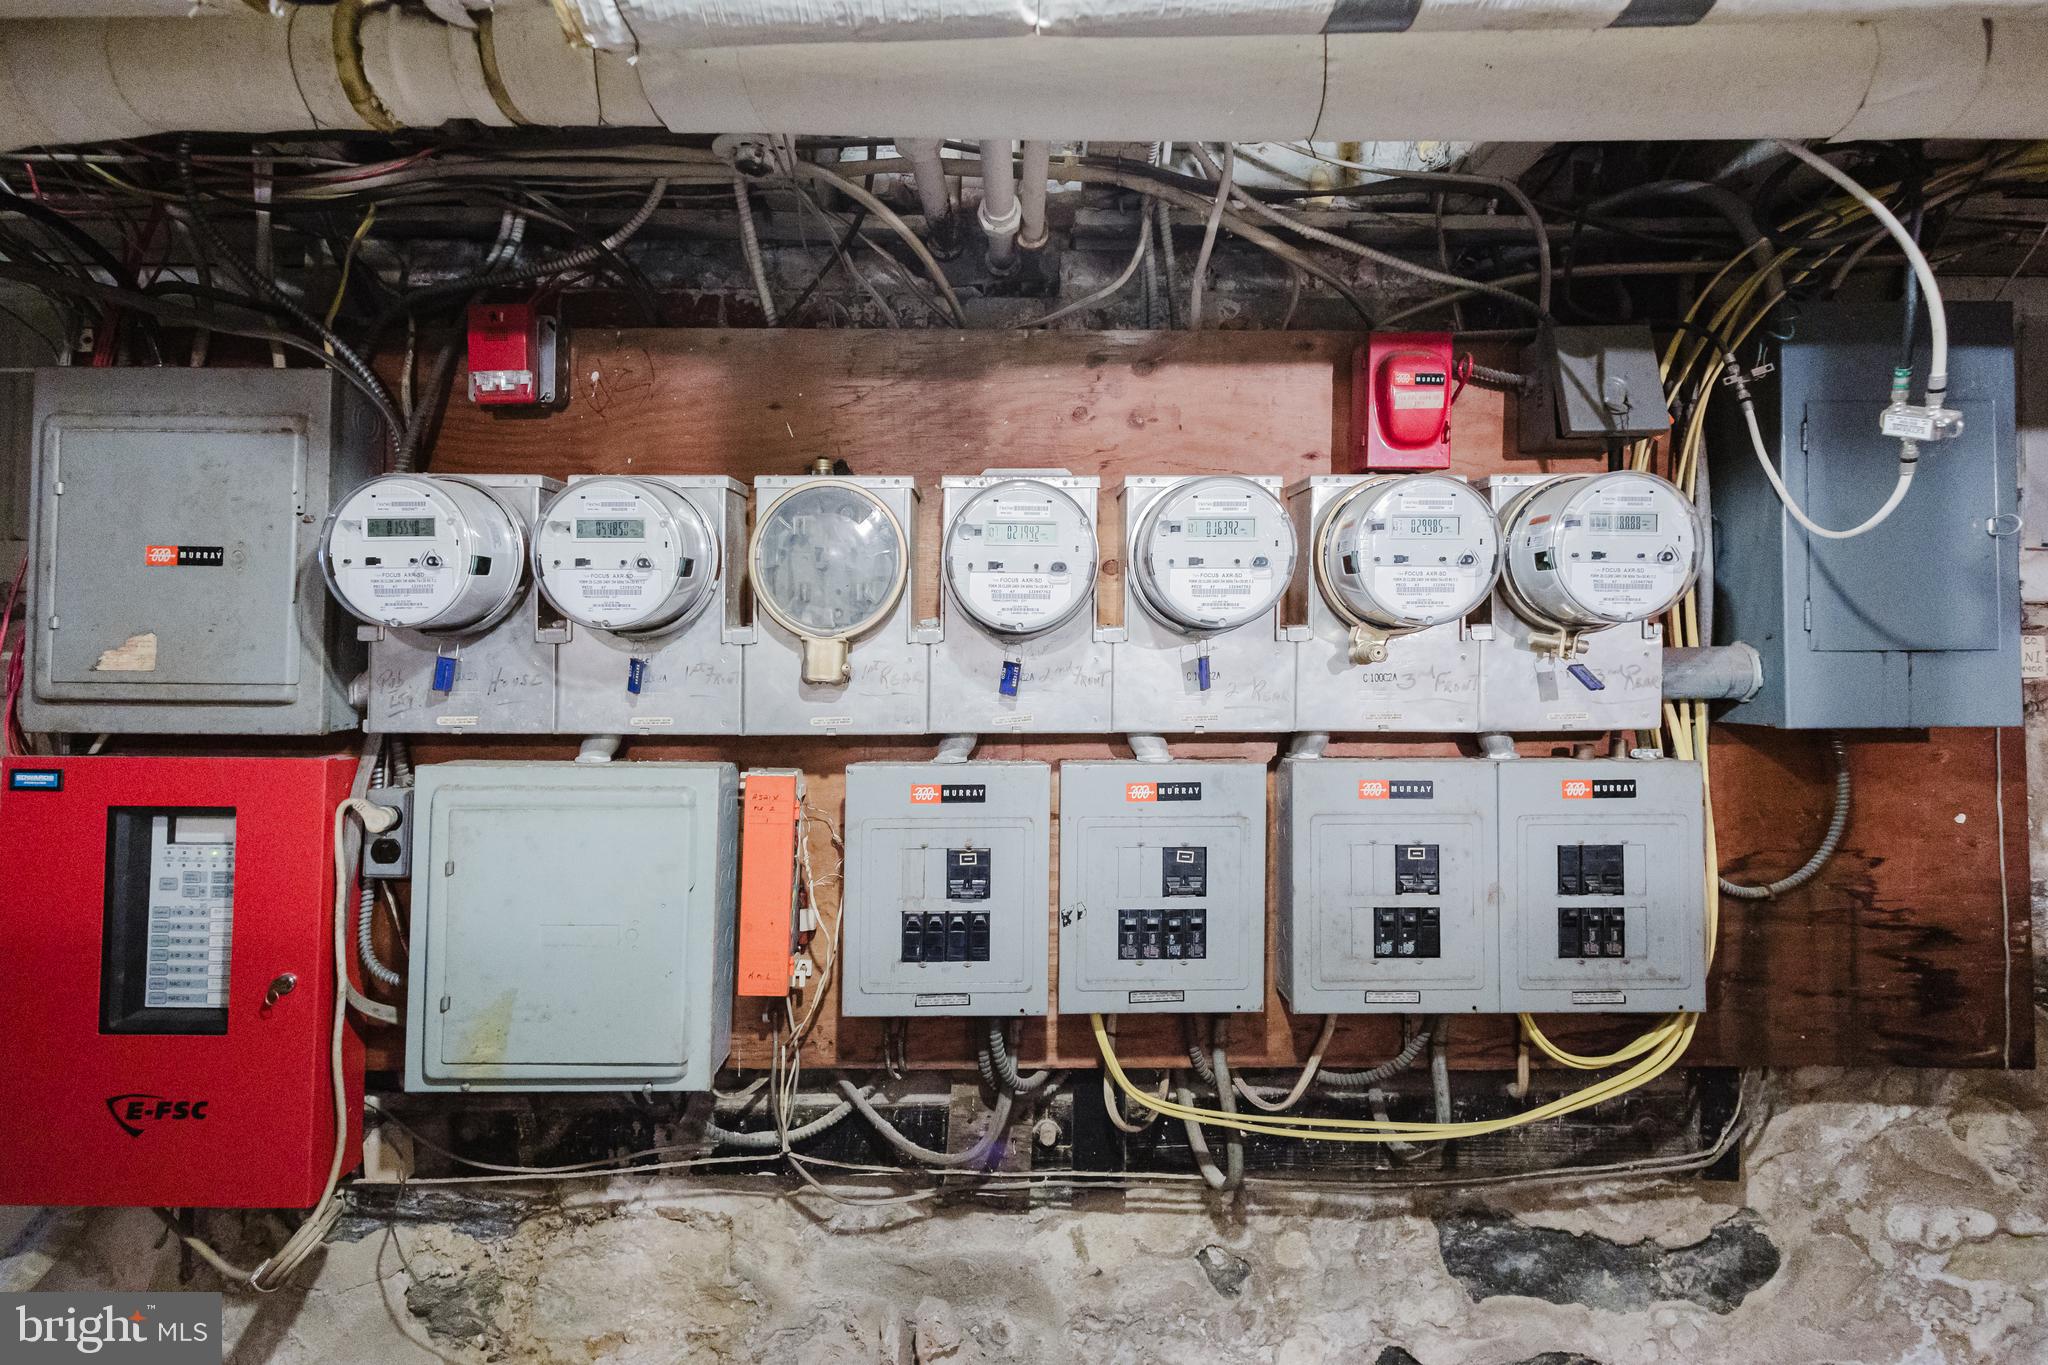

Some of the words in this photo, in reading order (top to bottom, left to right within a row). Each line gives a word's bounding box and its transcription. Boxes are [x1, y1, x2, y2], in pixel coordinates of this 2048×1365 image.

[943, 788, 984, 797] MURRAY
[1158, 787, 1200, 795] MURRAY
[1392, 784, 1432, 793] MURRAY
[1594, 784, 1634, 792] MURRAY
[126, 1102, 209, 1120] E-FSC
